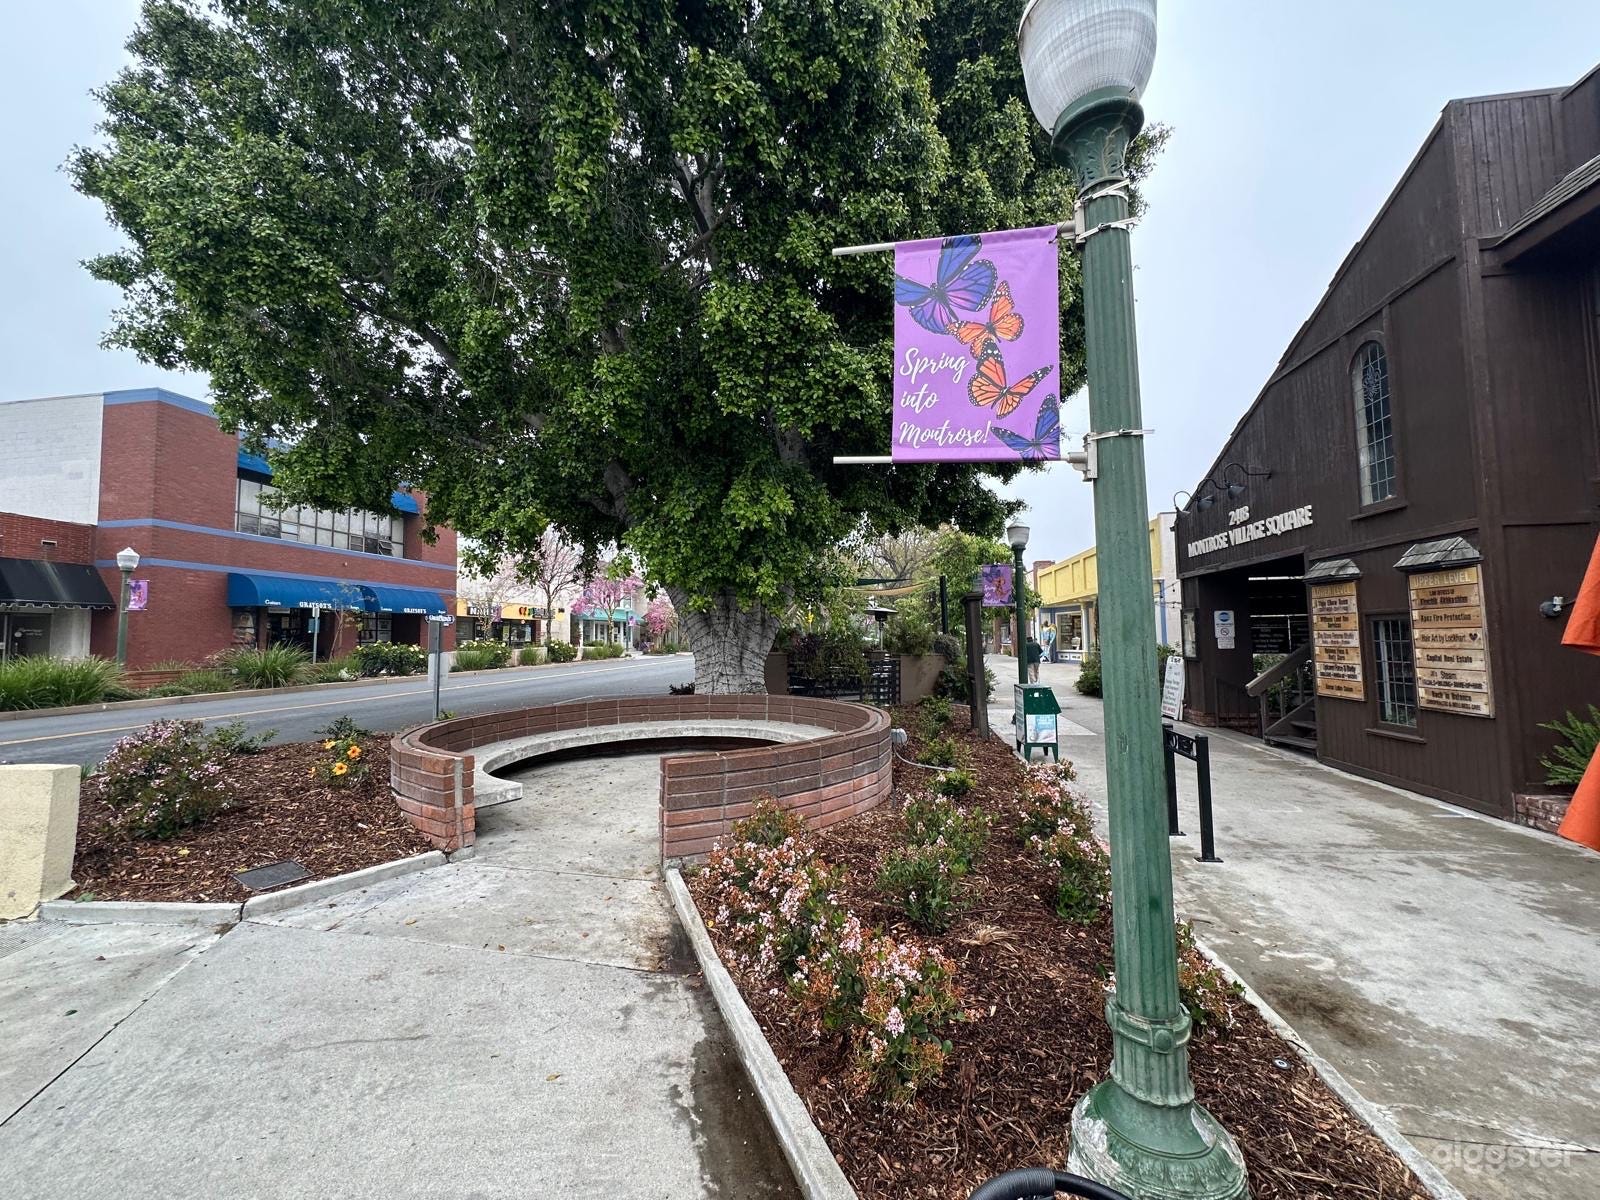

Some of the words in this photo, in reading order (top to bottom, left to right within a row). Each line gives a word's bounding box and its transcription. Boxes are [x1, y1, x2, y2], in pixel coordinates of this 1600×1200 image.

[900, 348, 969, 384] Spring
[901, 384, 938, 414] into
[900, 420, 992, 448] Montrose!
[1188, 532, 1228, 557] MONTROSE
[1228, 520, 1266, 546] VILLAGE
[1265, 505, 1313, 536] SQUARE
[1414, 574, 1440, 587] UPPER
[1443, 571, 1471, 584] LEVEL
[1426, 654, 1442, 662] Capital
